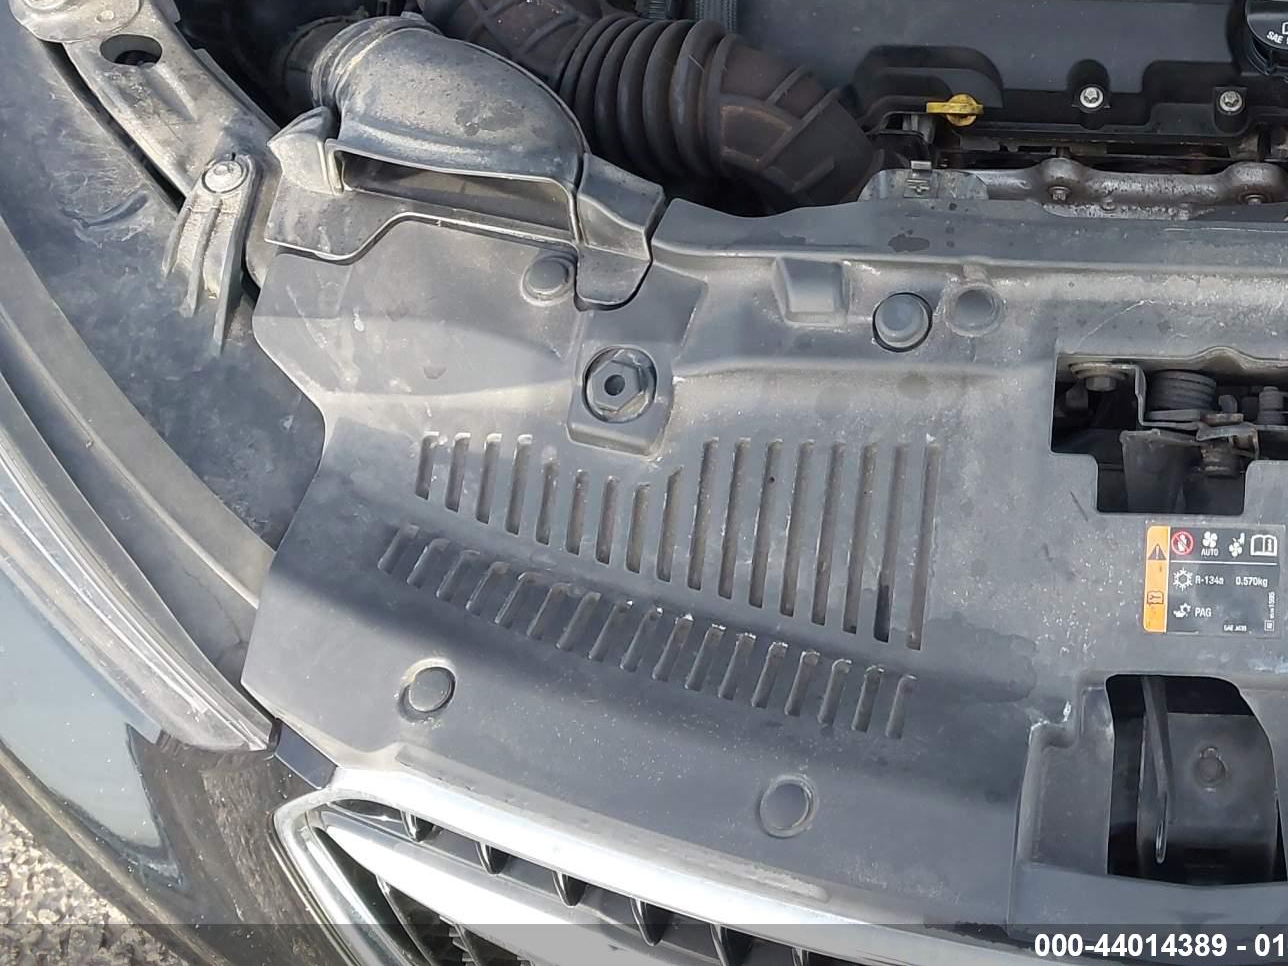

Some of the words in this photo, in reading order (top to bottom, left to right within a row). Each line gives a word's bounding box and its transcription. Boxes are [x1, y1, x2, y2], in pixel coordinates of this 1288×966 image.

[1267, 31, 1283, 44] SAE
[1200, 548, 1218, 557] AUTO
[1195, 575, 1224, 585] R-134a
[1235, 576, 1268, 587] 0.570kg
[1195, 607, 1212, 618] PAG
